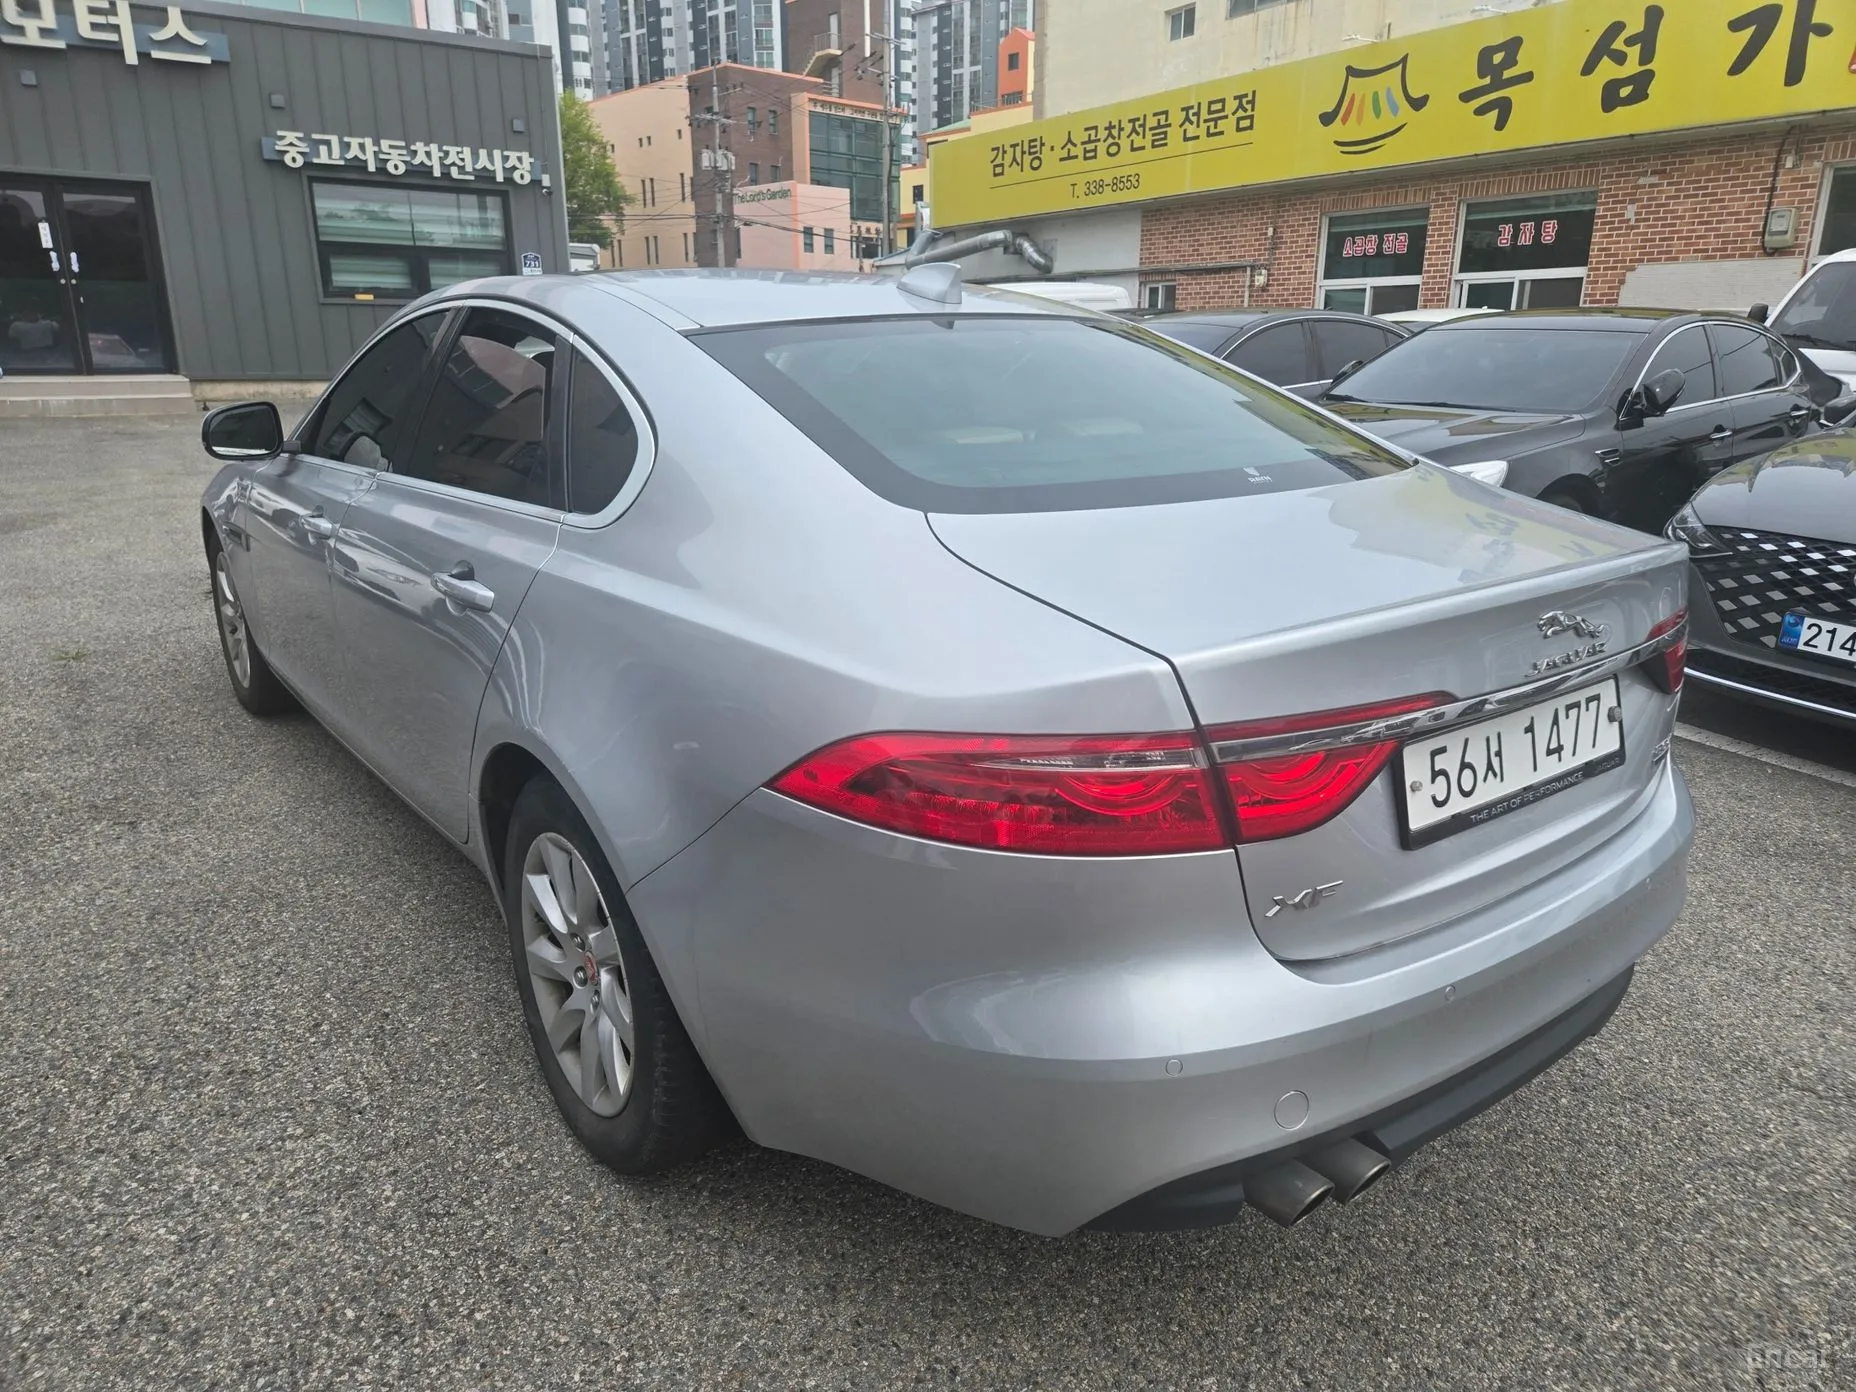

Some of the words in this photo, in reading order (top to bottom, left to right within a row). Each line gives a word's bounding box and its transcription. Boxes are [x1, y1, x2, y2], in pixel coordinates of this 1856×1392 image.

[0, 0, 212, 65] 모터스
[1178, 90, 1257, 142] 전문점
[275, 130, 535, 185] 중고자동차전시장
[1070, 183, 1080, 199] T.
[1084, 173, 1141, 197] 338-8553
[1343, 235, 1378, 257] 소곱창
[1383, 233, 1408, 255] 전골
[1498, 220, 1558, 247] 감자탕
[525, 260, 539, 268] 731
[1803, 623, 1856, 656] 214
[1524, 641, 1607, 677] JAGUAR
[1430, 732, 1504, 808] 56서
[1524, 693, 1601, 772] 1477
[1470, 809, 1489, 823] THE
[1491, 801, 1509, 815] ART
[1510, 796, 1522, 808] OF
[1523, 771, 1584, 803] PERFORMANCE
[1265, 880, 1343, 917] XF
